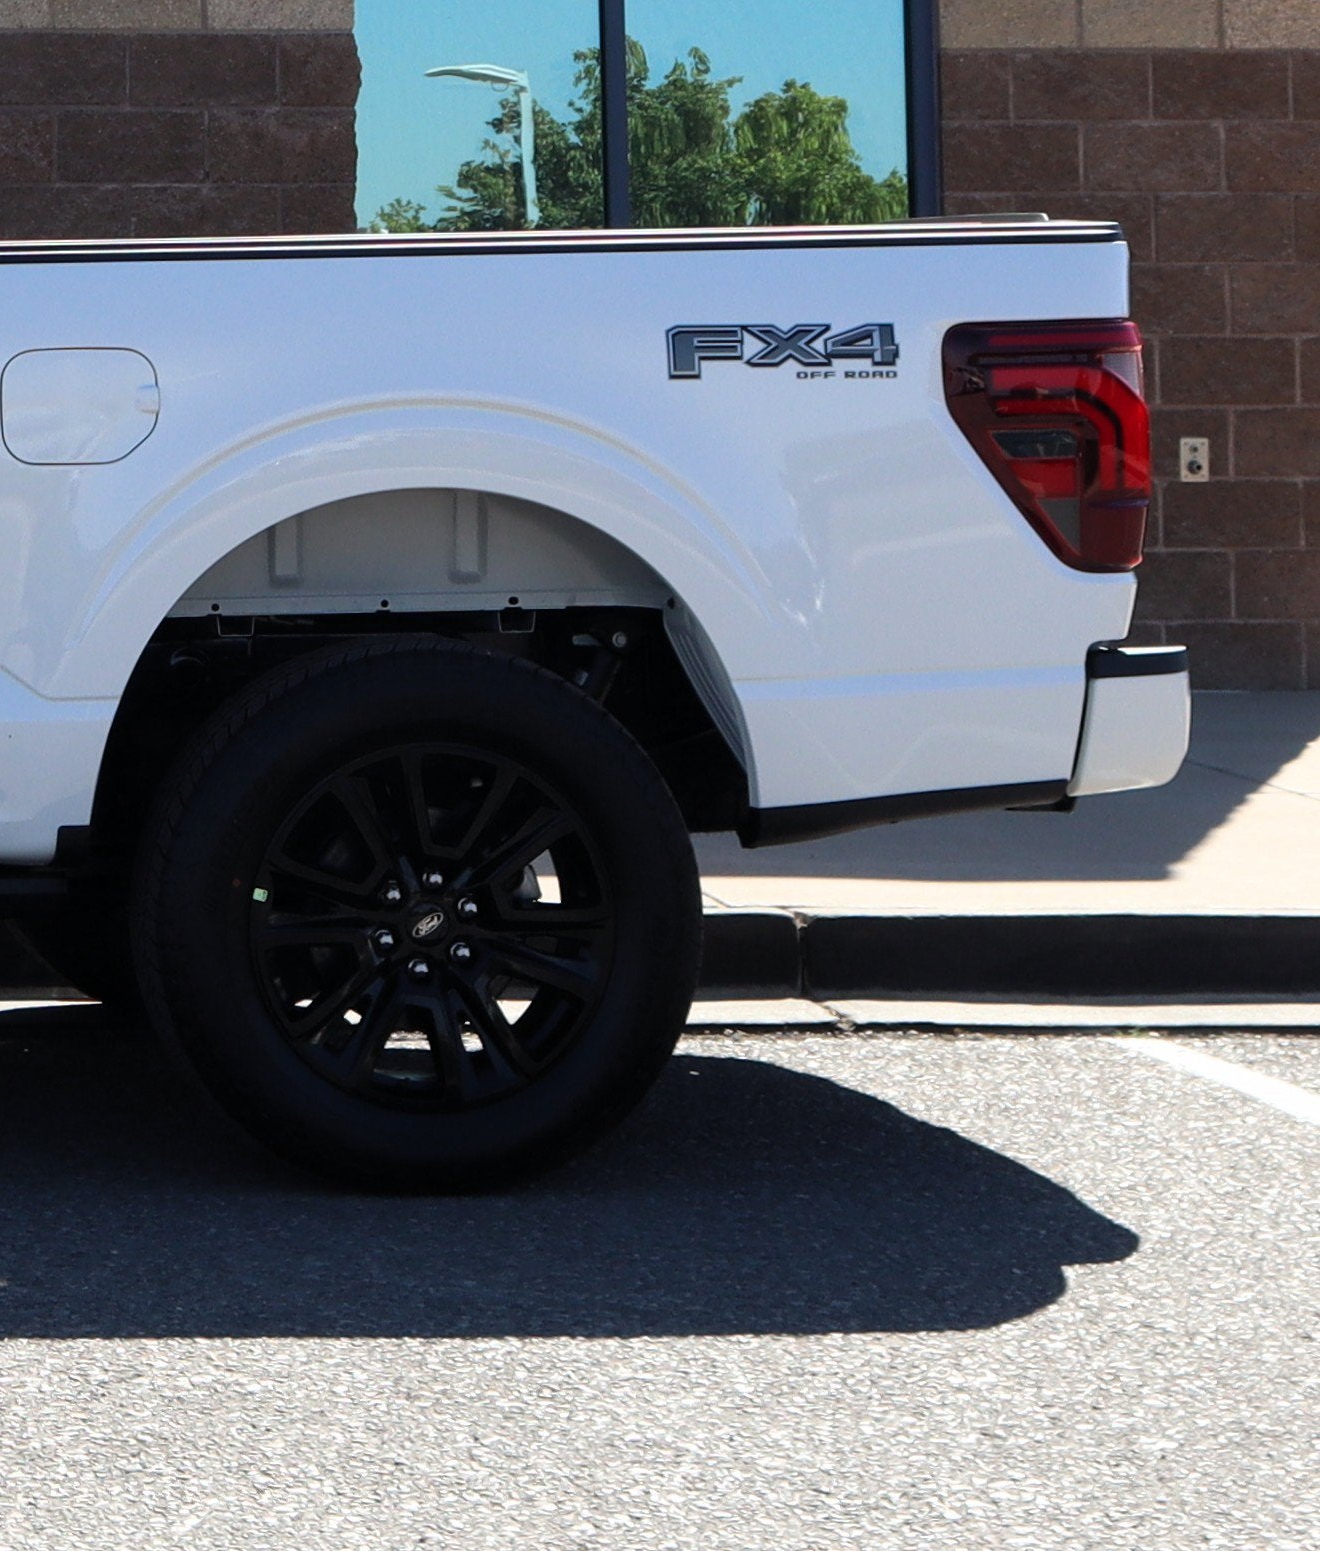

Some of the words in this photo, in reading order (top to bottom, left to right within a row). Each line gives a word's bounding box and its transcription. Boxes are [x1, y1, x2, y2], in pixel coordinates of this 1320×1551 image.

[665, 322, 900, 380] FX4
[795, 370, 836, 380] OFF
[844, 369, 898, 379] ROAD
